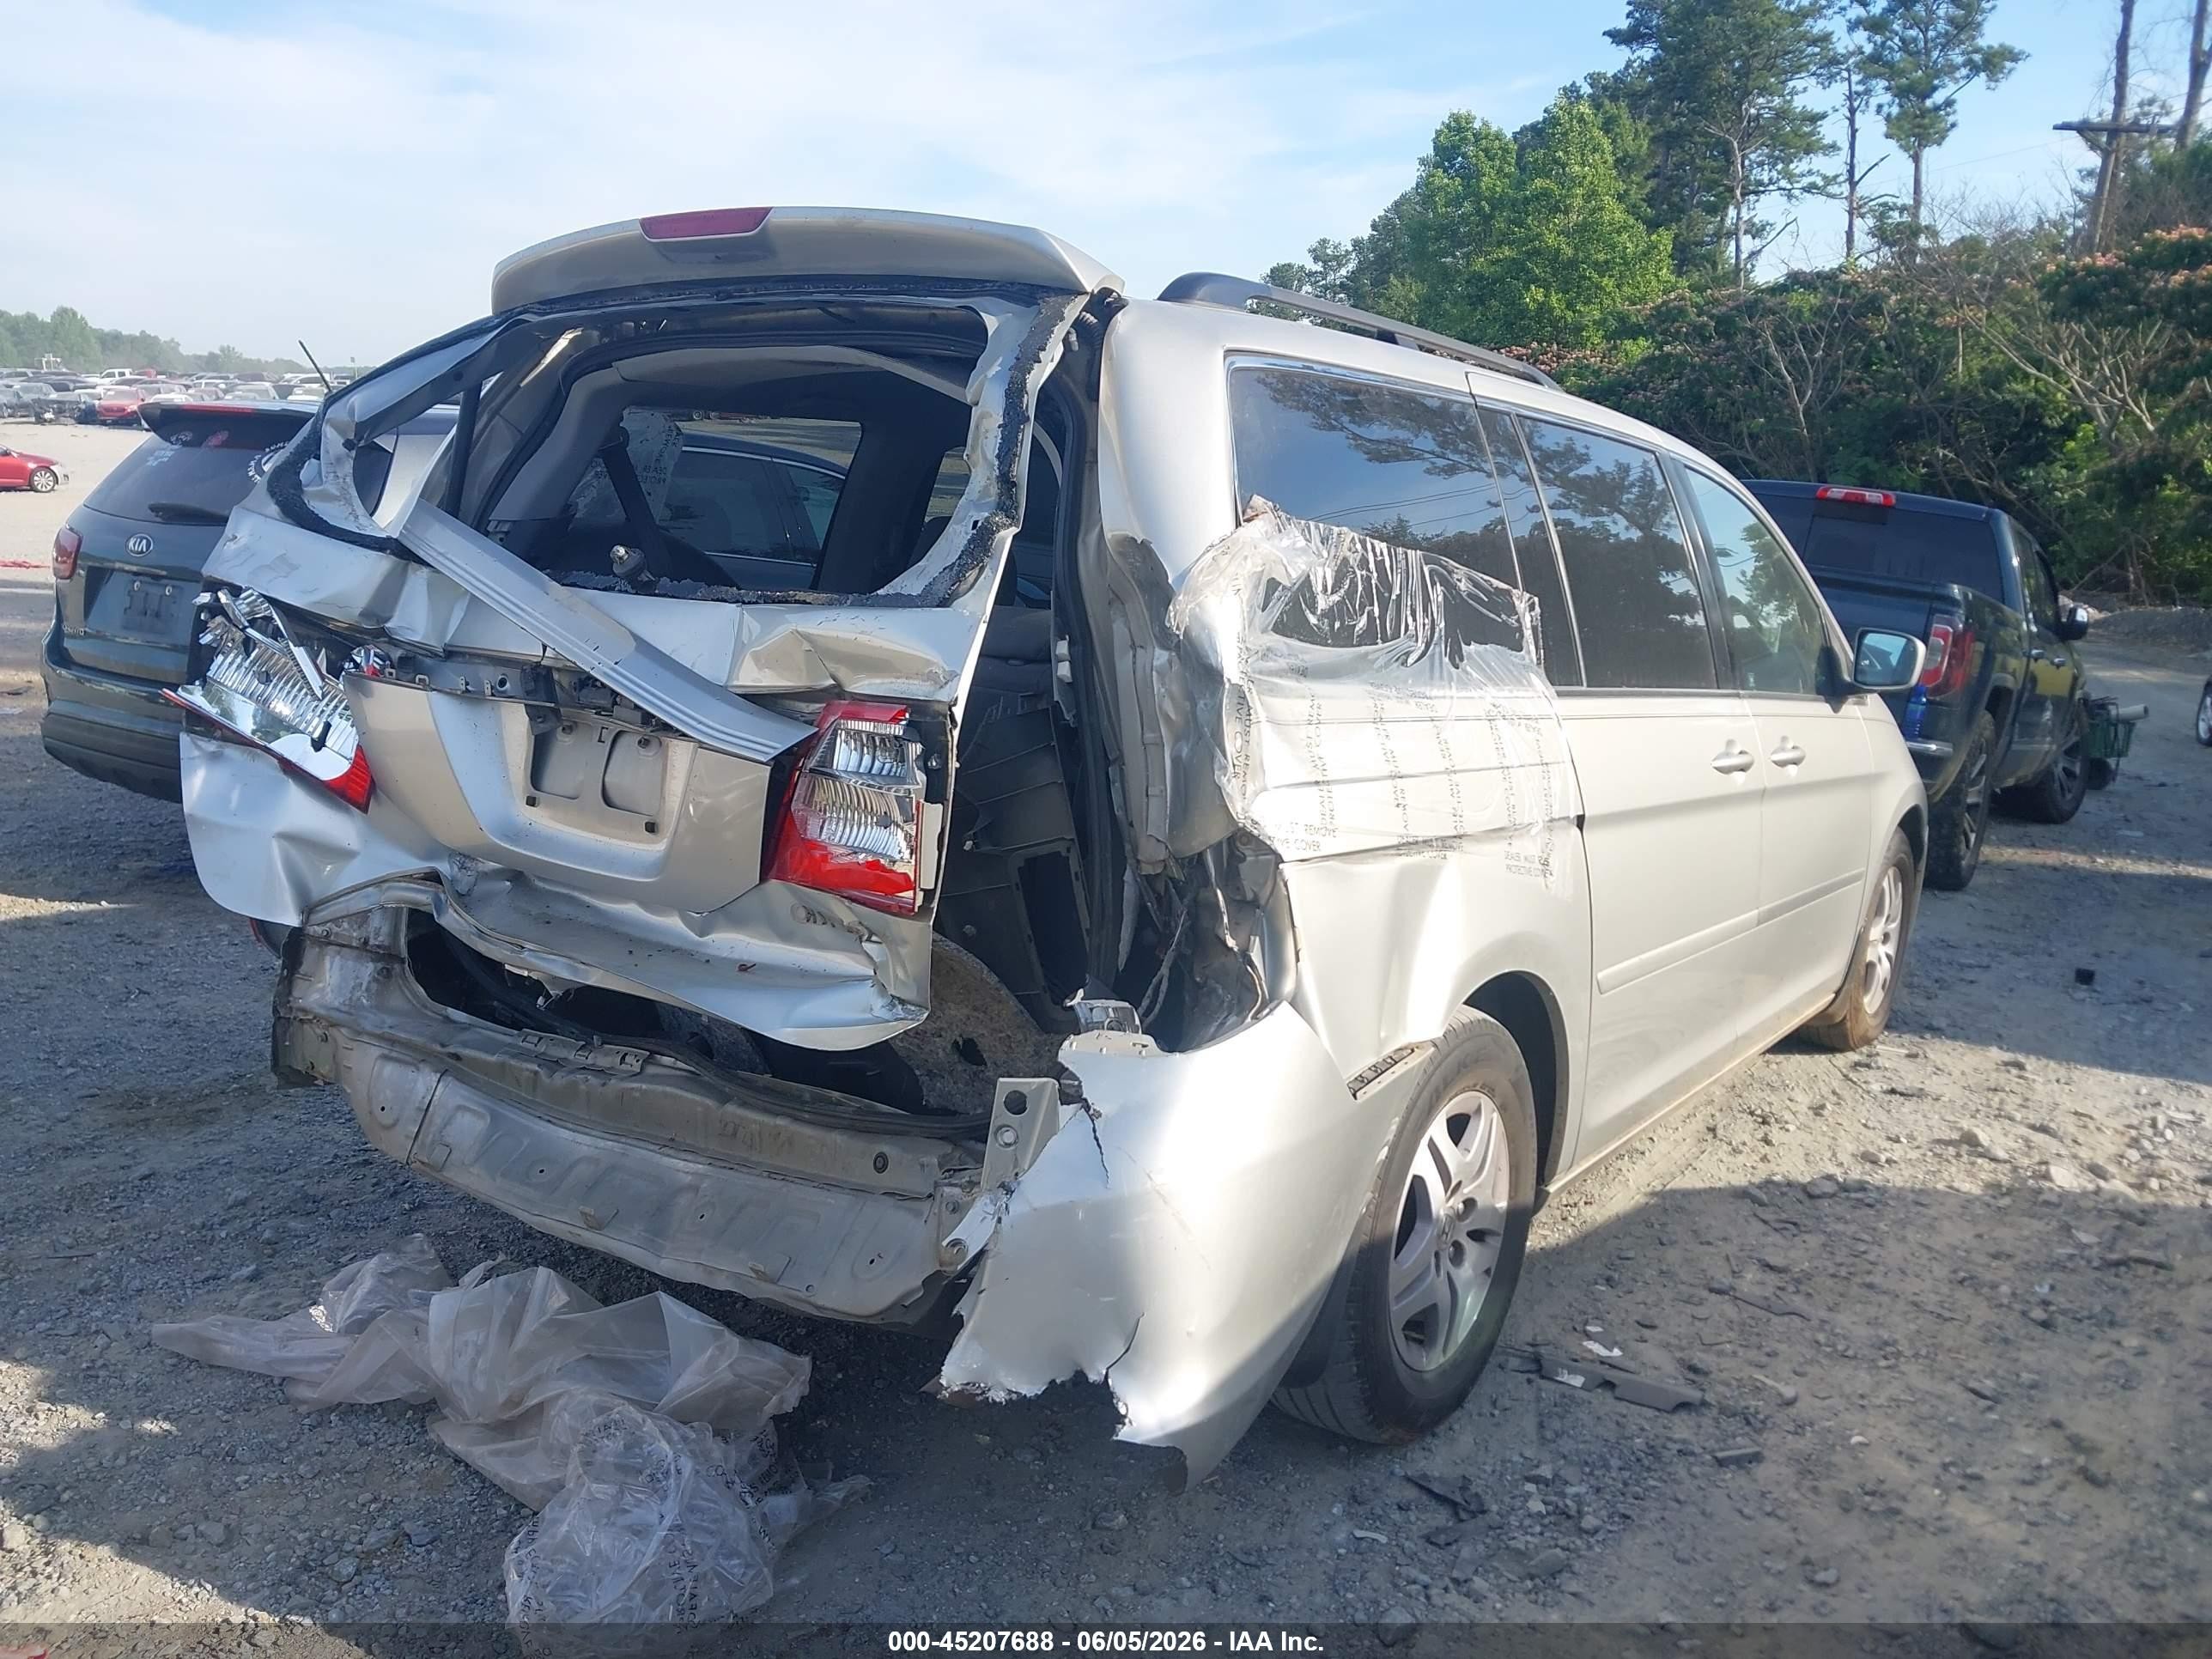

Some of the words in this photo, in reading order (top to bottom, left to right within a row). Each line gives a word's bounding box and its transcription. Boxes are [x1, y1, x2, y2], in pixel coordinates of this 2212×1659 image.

[128, 538, 147, 552] KIA
[1243, 705, 1254, 747] MUST
[1231, 731, 1243, 780] COVER
[1241, 753, 1251, 800] REMO
